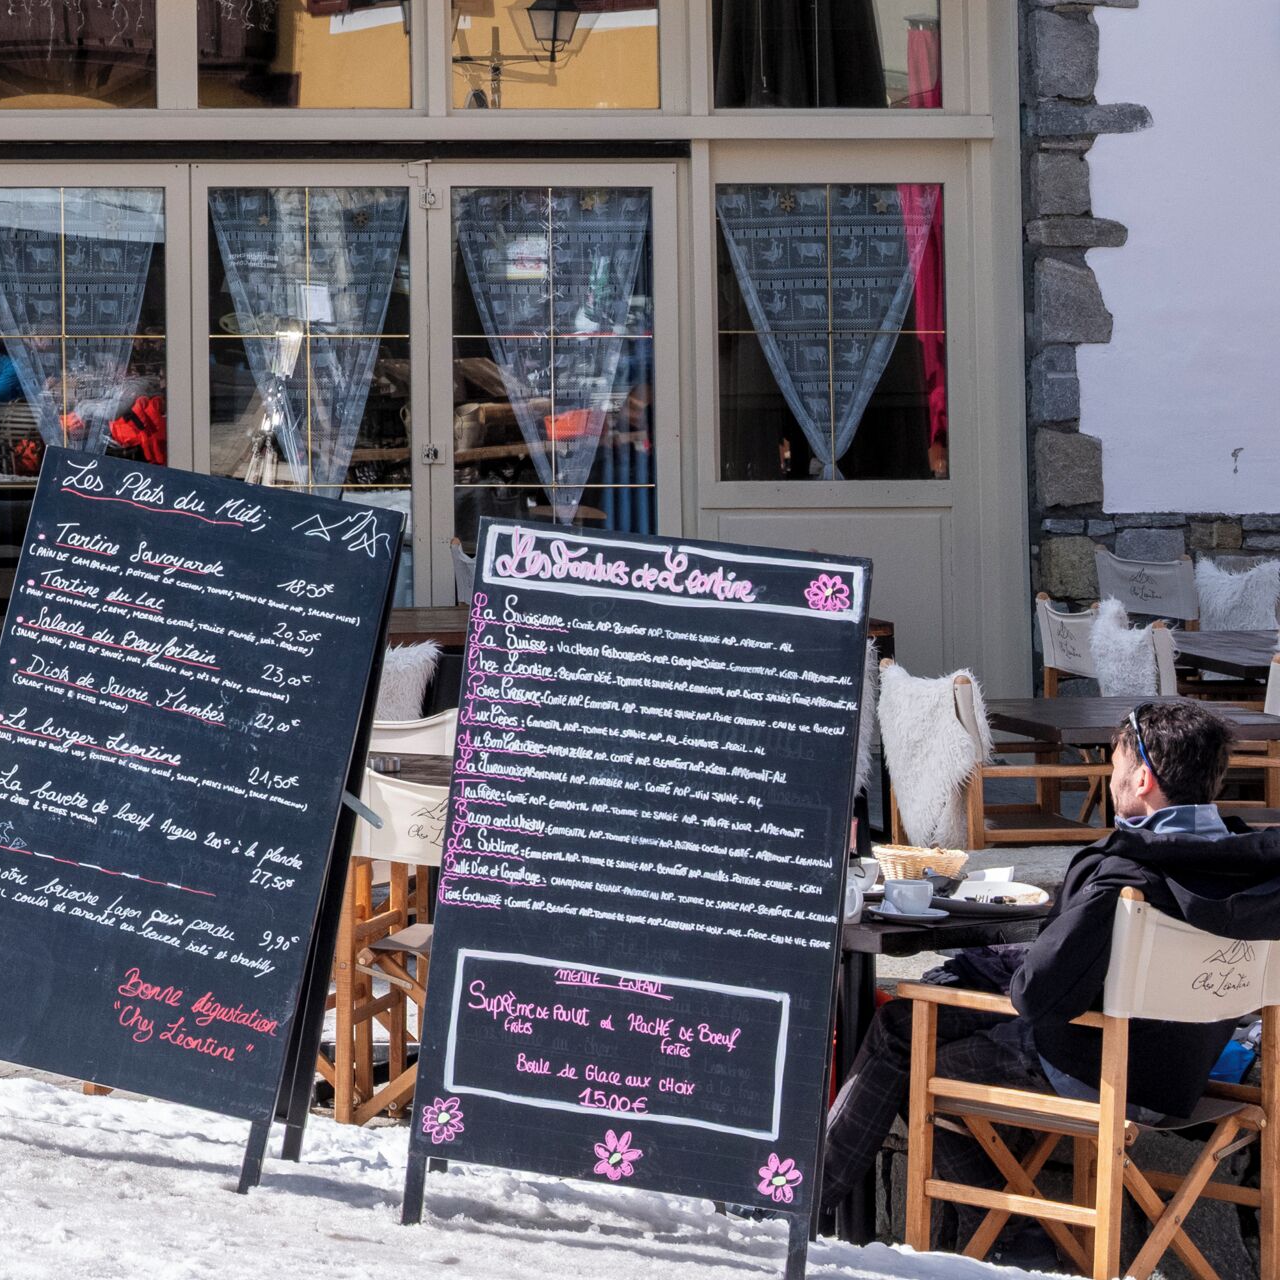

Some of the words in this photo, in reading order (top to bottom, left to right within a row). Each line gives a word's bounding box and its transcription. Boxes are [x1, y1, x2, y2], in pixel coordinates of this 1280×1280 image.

[62, 459, 103, 491] Les
[115, 471, 163, 504] Plats
[173, 490, 205, 511] du
[56, 522, 119, 554] Tartine
[129, 540, 224, 576] Savoyarde
[495, 531, 554, 578] Les
[546, 539, 629, 585] Fondues
[40, 568, 99, 598] Tartine
[105, 586, 132, 601] du
[135, 591, 164, 609] Lac
[276, 579, 334, 597] 18,50€
[470, 591, 496, 620] La
[28, 606, 84, 636] Salade
[91, 628, 114, 643] du
[118, 630, 215, 663] Beaufortain
[272, 622, 321, 642] 20,50€
[469, 620, 498, 646] La
[504, 624, 550, 652] Suisse
[260, 663, 311, 687] 23,00€
[467, 646, 498, 673] Chez
[26, 653, 68, 681] Diots
[75, 672, 94, 688] de
[99, 675, 148, 701] Savoie
[155, 686, 224, 721] Flambés
[2, 707, 27, 729] Le
[29, 717, 97, 755] burger
[253, 712, 300, 732] 22,00€
[247, 766, 299, 788] 21,50€
[29, 780, 88, 808] bavette
[91, 799, 108, 814] de
[159, 818, 197, 840] Angus
[453, 798, 493, 825] Bacon
[446, 823, 474, 850] La
[477, 825, 521, 855] Sublime
[33, 877, 99, 905] brioche
[141, 909, 183, 931] pain
[181, 919, 234, 940] perdu
[11, 892, 48, 907] coulis
[52, 901, 66, 912] de
[119, 922, 134, 931] au
[213, 951, 227, 959] et
[230, 952, 275, 977] chantilly
[258, 930, 299, 951] 9,90€
[117, 967, 182, 1006] Bonne
[190, 991, 277, 1036] dégustation
[516, 1052, 551, 1074] Boule
[556, 1063, 578, 1079] de
[585, 1064, 621, 1085] Glace
[624, 1075, 651, 1087] aux
[578, 1087, 648, 1115] 15.00€
